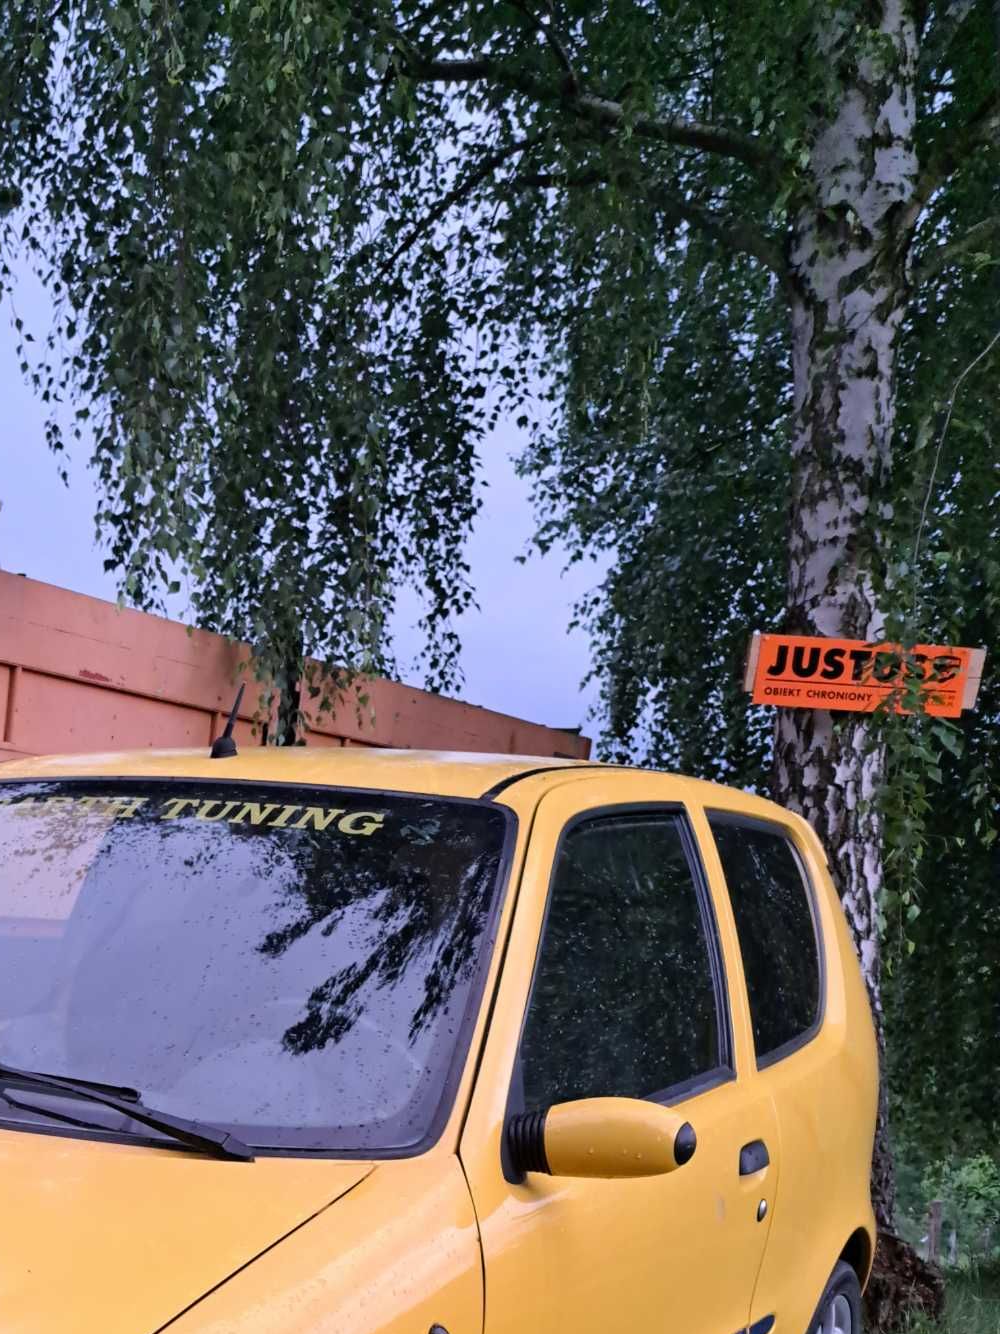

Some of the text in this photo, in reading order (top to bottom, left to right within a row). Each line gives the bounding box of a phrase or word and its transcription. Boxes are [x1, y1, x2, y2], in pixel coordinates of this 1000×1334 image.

[764, 687, 873, 702] OBIEKT CHRONIONY
[159, 798, 385, 836] TUNING
